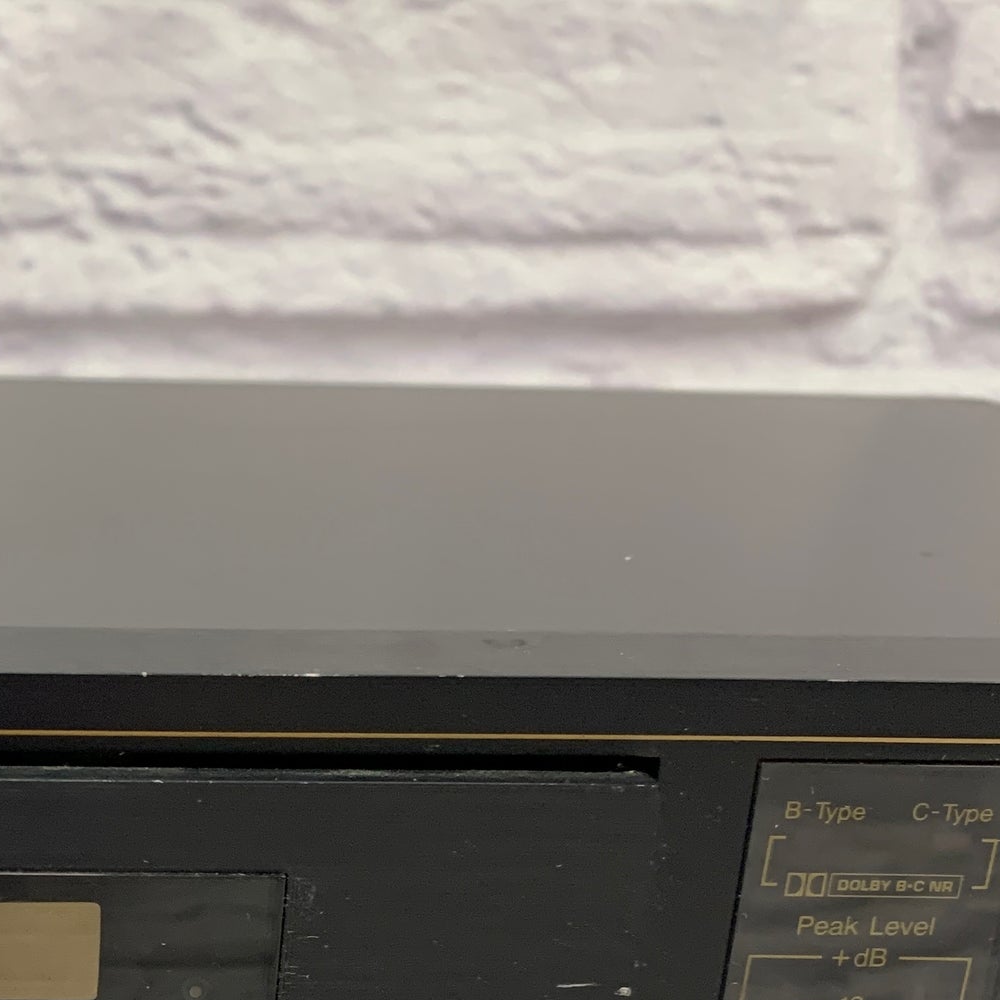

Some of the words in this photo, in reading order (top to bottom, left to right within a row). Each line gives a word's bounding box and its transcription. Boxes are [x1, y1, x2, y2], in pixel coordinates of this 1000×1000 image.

[784, 801, 866, 824] B-Type
[912, 803, 994, 826] C-Type
[796, 915, 858, 936] Peak
[869, 916, 936, 936] Level
